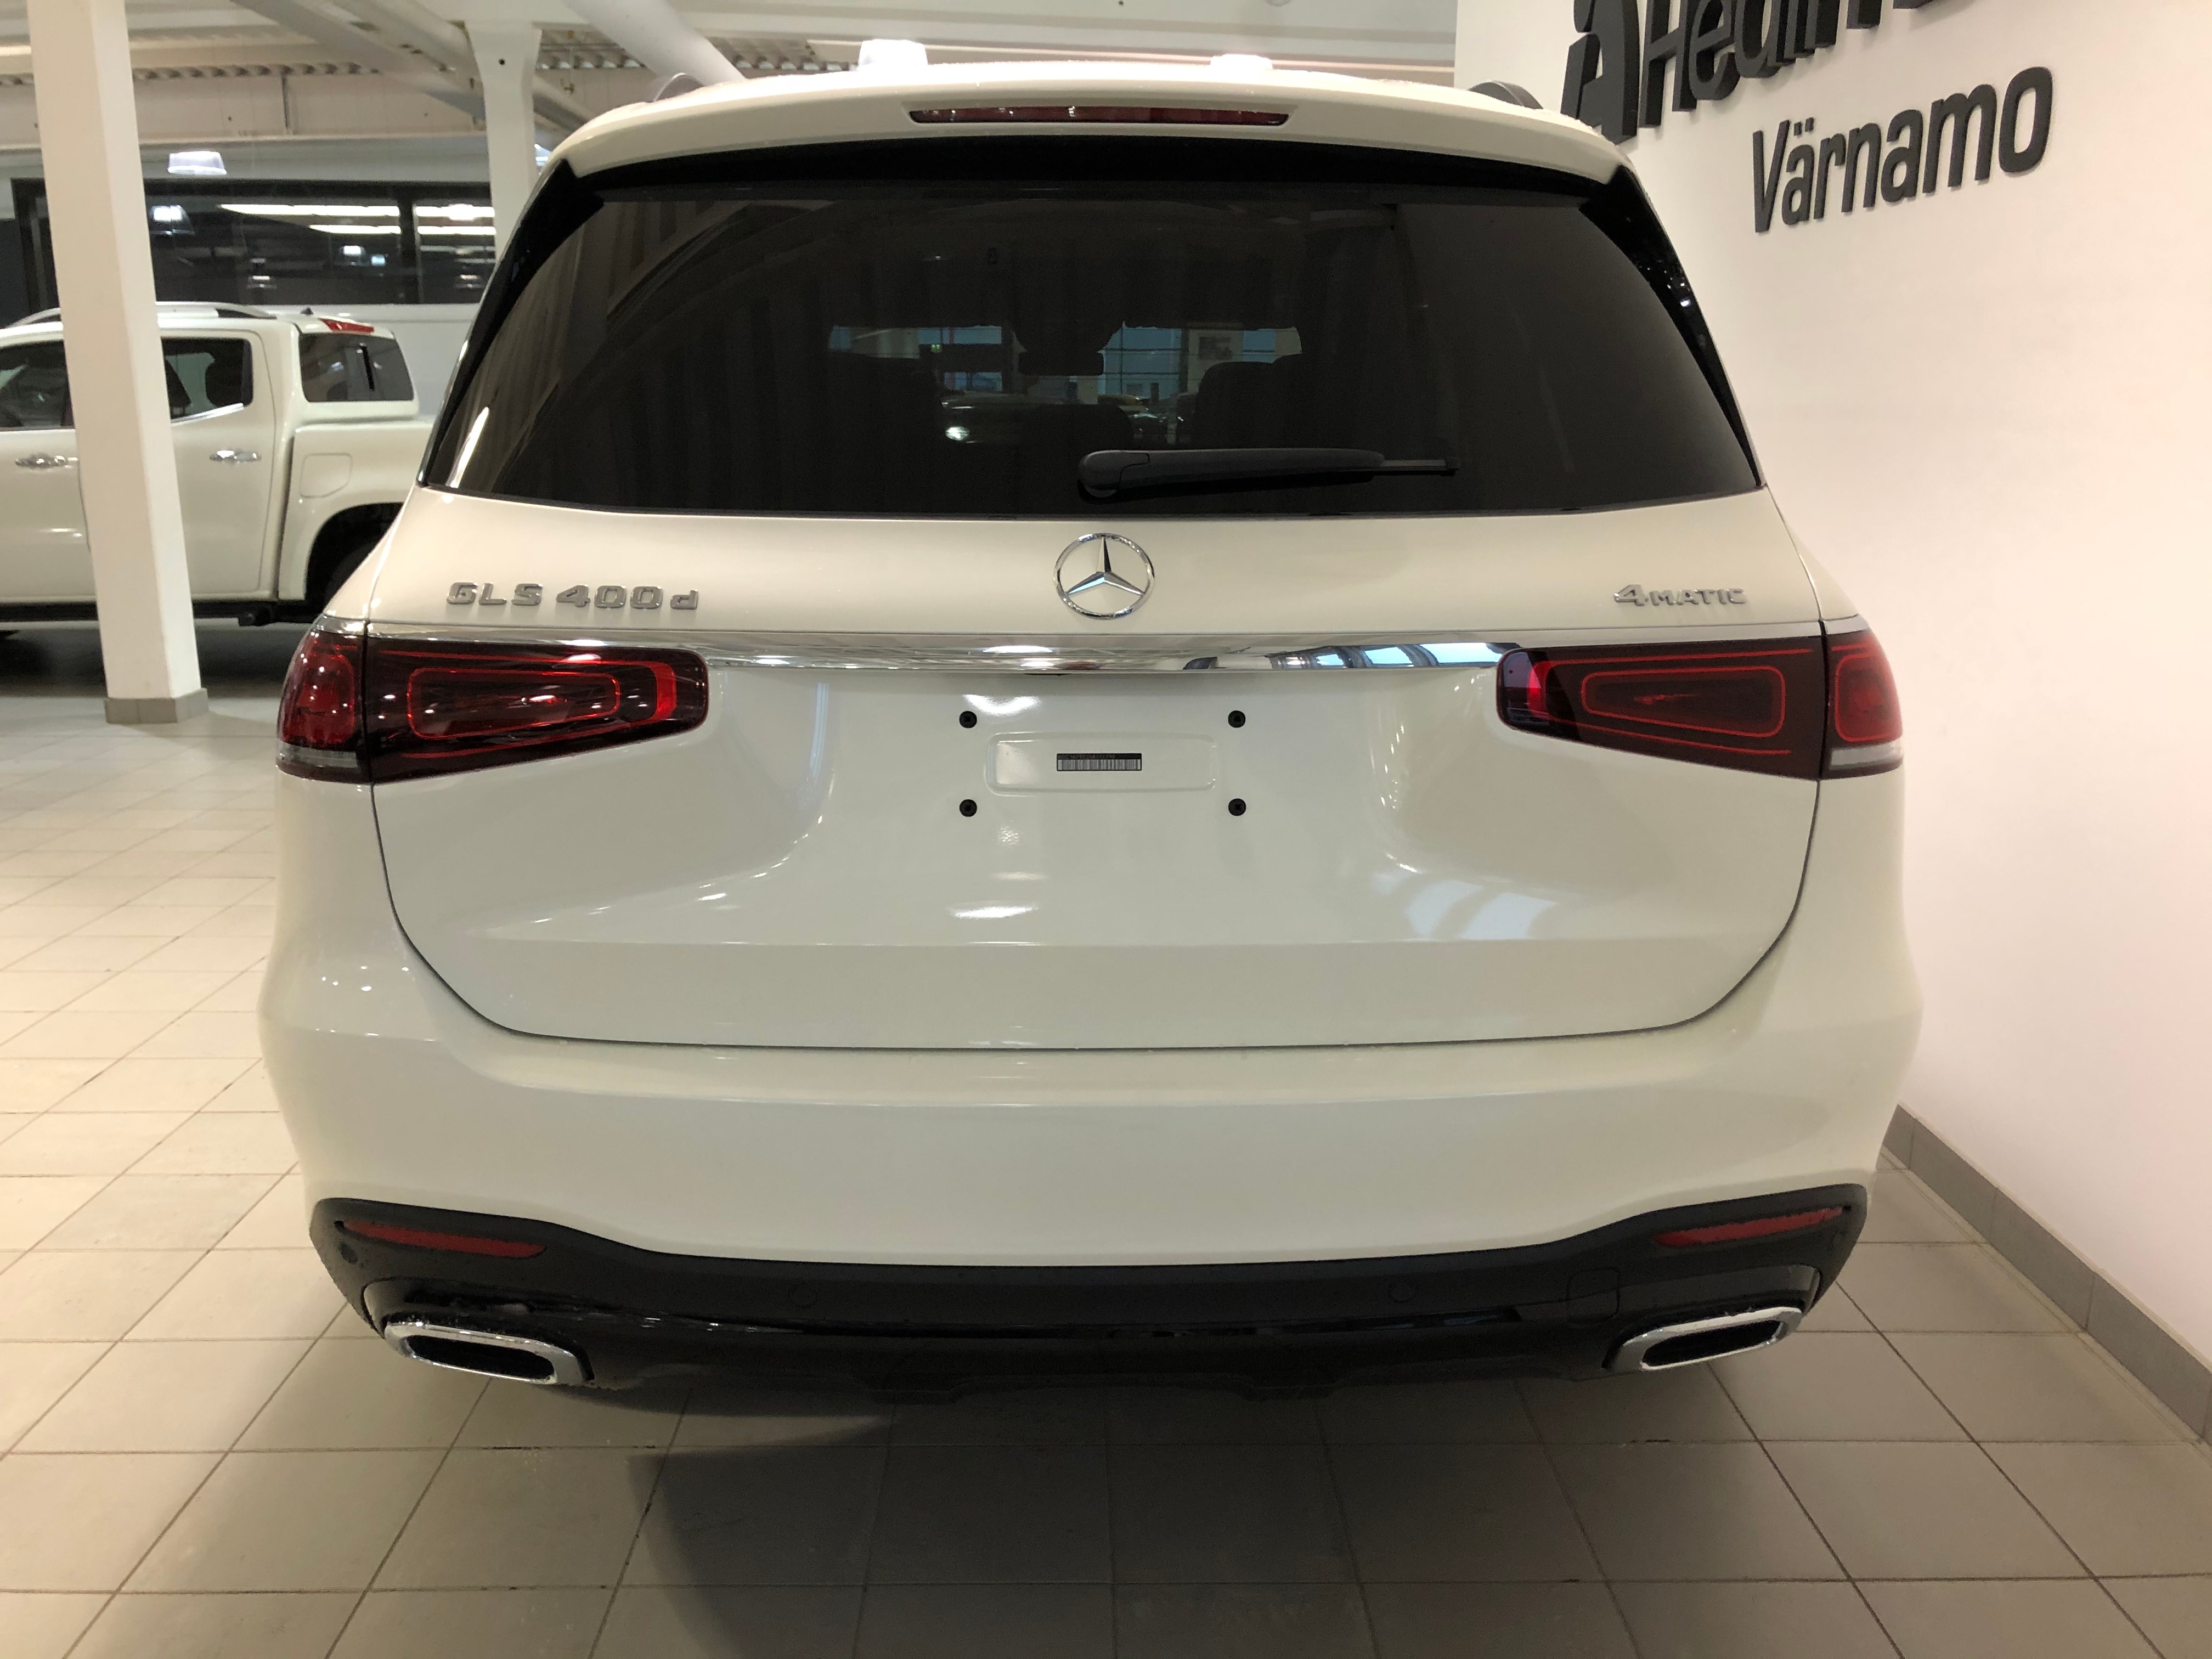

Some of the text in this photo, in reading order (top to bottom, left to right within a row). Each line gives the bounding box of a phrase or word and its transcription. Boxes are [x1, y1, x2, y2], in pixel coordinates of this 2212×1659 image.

[1753, 66, 2053, 233] Värnamo
[447, 582, 543, 606] GLS
[1614, 584, 1748, 606] 4MATIC
